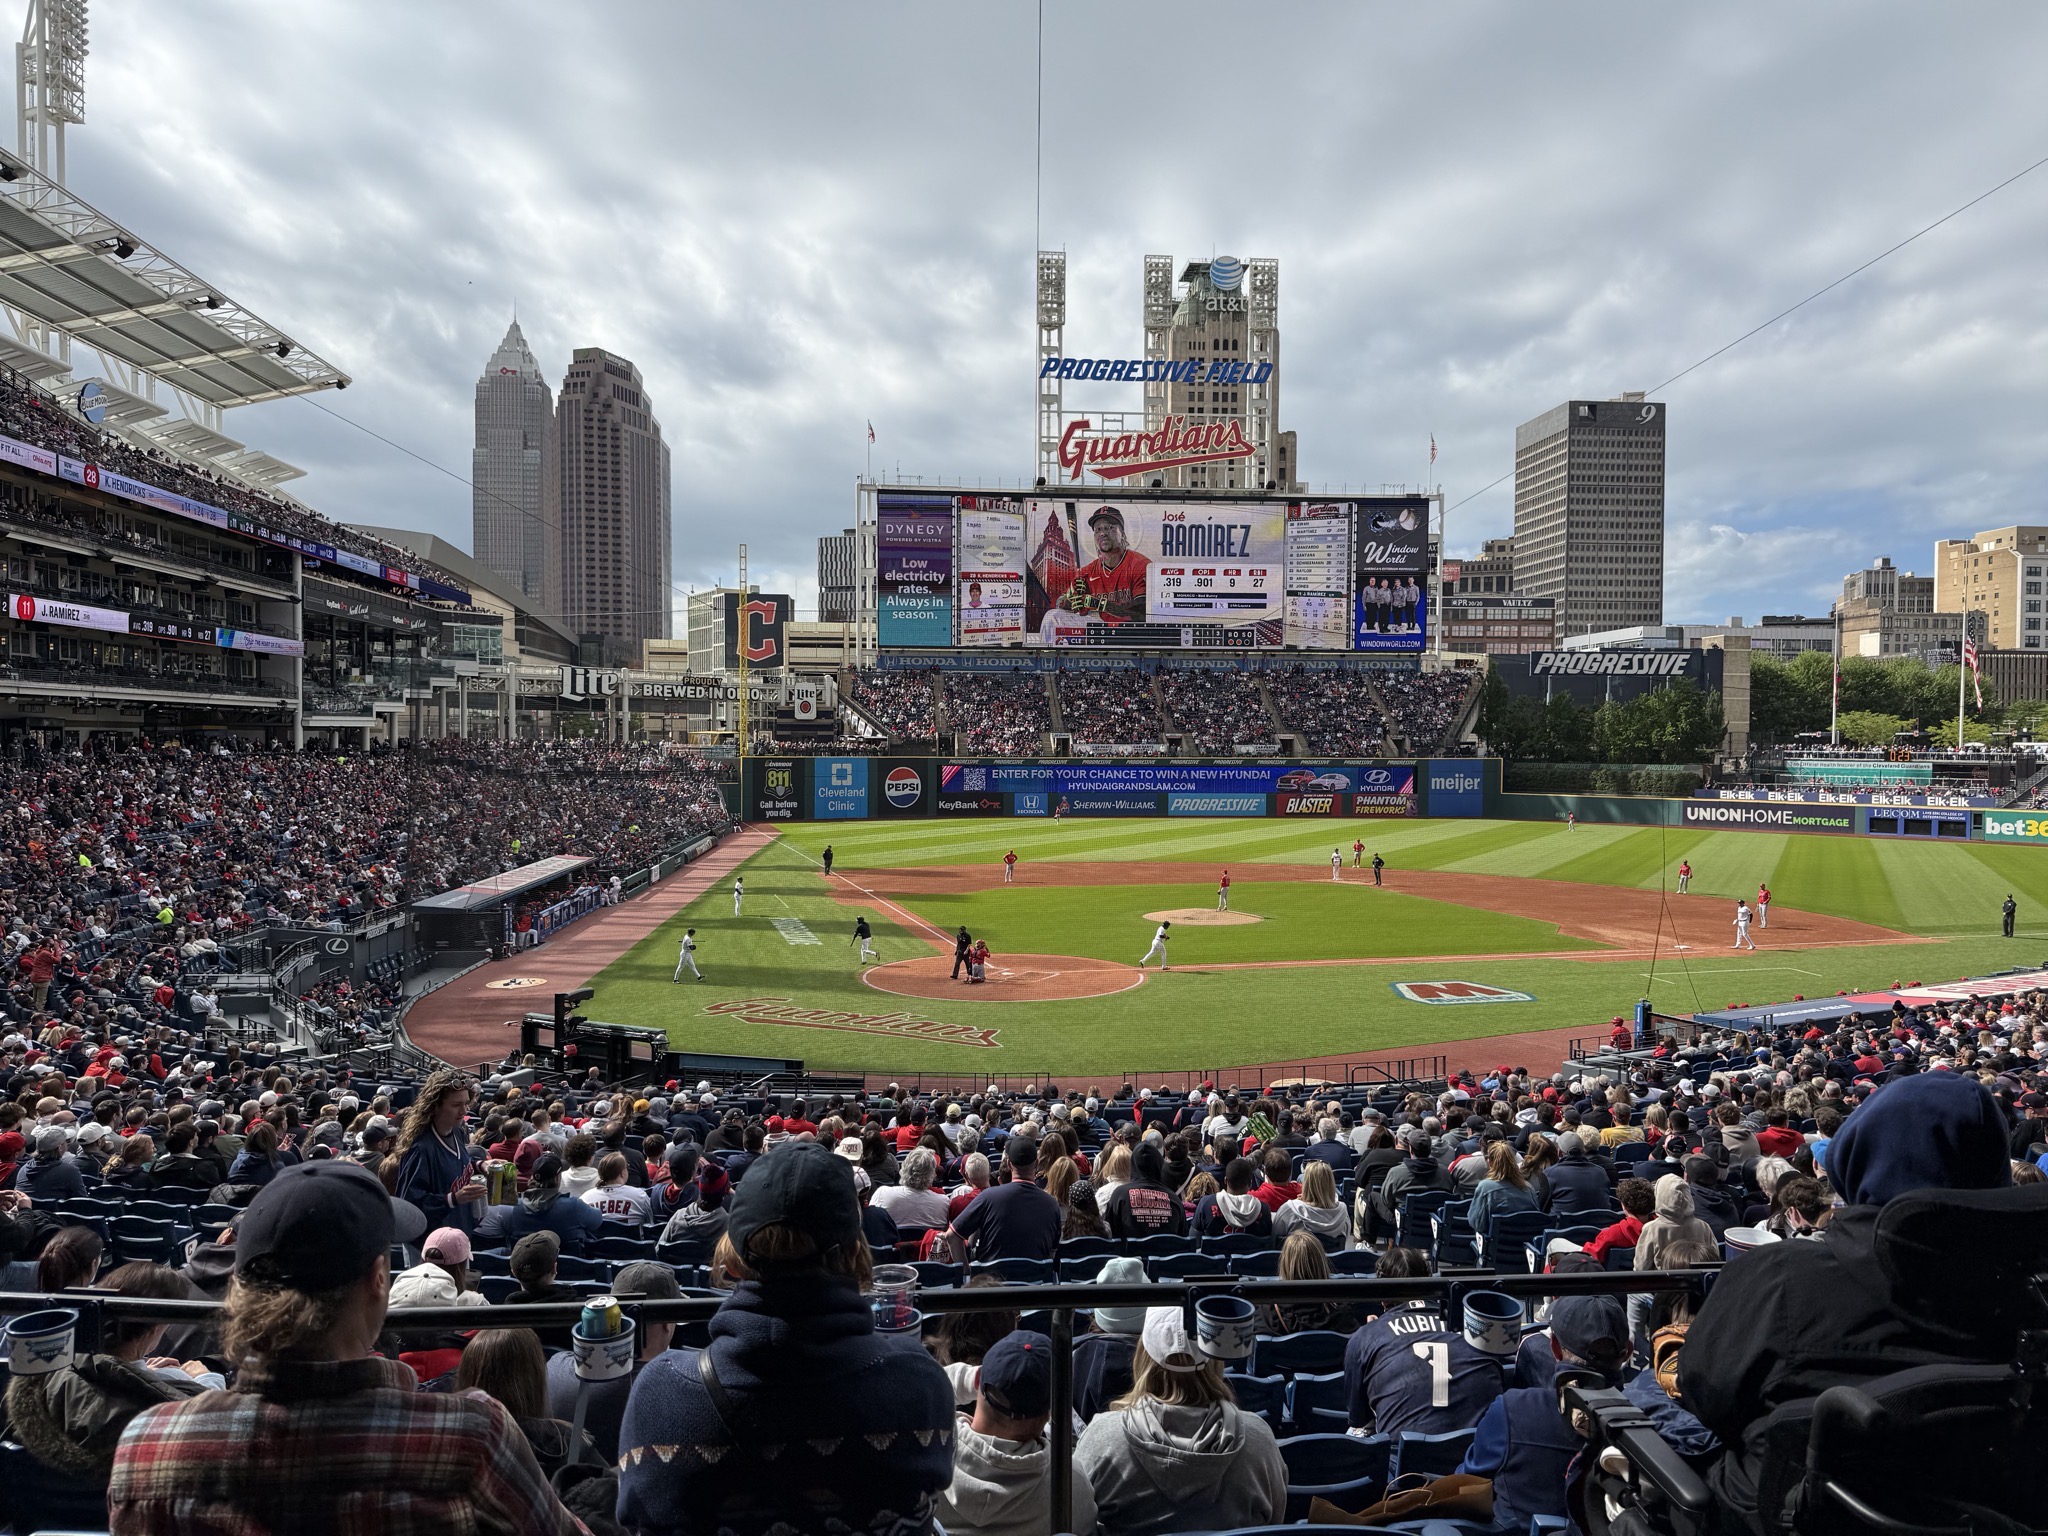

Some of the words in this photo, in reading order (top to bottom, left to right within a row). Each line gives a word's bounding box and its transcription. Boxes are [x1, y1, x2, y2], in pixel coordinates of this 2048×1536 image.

[1205, 295, 1248, 312] at&t
[1039, 357, 1202, 383] PROGRESSIVE
[1204, 361, 1274, 384] FIELD
[1640, 404, 1657, 425] 9
[1057, 415, 1257, 482] Guardians
[32, 454, 53, 469] Ohio.org
[86, 469, 97, 484] 28
[111, 479, 146, 499] HENDRICKS
[980, 499, 1016, 514] ANGELS
[1307, 504, 1340, 518] Guardians
[1162, 510, 1186, 522] José
[885, 524, 945, 536] DYNEGY
[1161, 516, 1252, 558] RAMÍREZ
[901, 557, 928, 569] Low
[884, 570, 945, 585] electricity
[1163, 577, 1182, 587] .319
[1194, 578, 1213, 587] .901
[1229, 578, 1236, 587] 9
[1253, 578, 1264, 588] 27
[898, 584, 932, 594] rates.
[2, 602, 7, 613] 2
[22, 601, 31, 616] 11
[326, 599, 340, 610] KeyBank
[886, 596, 931, 610] Always
[931, 596, 944, 607] in
[41, 604, 48, 617] J.
[49, 604, 80, 621] RAMÍREZ
[892, 610, 938, 620] season.
[141, 621, 154, 633] .319
[166, 625, 178, 636] .901
[204, 630, 211, 640] 27
[737, 600, 777, 663] C
[1360, 640, 1421, 648] WINDOWWORLD.COM
[898, 657, 957, 667] HONDA
[975, 657, 1034, 667] HONDA
[1077, 658, 1136, 668] HONDA
[1181, 659, 1239, 668] HONDA
[1283, 660, 1339, 669] HONDA
[1357, 660, 1414, 669] HONDA
[1533, 653, 1692, 676] PROGRESSIVE
[558, 664, 619, 702] Lite
[683, 677, 723, 686] PROUDLY
[642, 684, 705, 698] BREWED
[709, 685, 724, 699] IN
[796, 688, 815, 700] Lite
[1889, 749, 1910, 762] 0:23
[767, 770, 790, 788] 811
[992, 769, 1029, 779] ENTER
[1031, 769, 1054, 779] FOR
[1055, 769, 1087, 779] YOUR
[1089, 770, 1137, 780] CHANCE
[1138, 770, 1154, 780] TO
[1155, 770, 1179, 780] WIN
[1180, 770, 1188, 780] A
[1189, 770, 1219, 780] NEW
[1220, 770, 1270, 780] HYUNDAI
[887, 782, 919, 792] PEPSI
[1068, 782, 1196, 791] HYUNDAIGRANDSLAM.COM
[1431, 773, 1481, 794] meijer
[818, 787, 865, 798] Cleveland
[759, 800, 774, 809] Call
[775, 800, 798, 809] before
[828, 800, 855, 811] Clinic
[938, 801, 979, 810] KeyBank
[1073, 800, 1156, 810] SHERWIN-WILLIAMS.
[1170, 798, 1262, 811] PROGRESSIVE
[1286, 798, 1333, 814] BLASTER
[1356, 796, 1407, 806] PHANTOM
[766, 810, 779, 819] you
[779, 809, 793, 818] dig.
[1355, 805, 1406, 815] FIREWORKS
[1686, 807, 1793, 825] UNIONHOME
[1792, 816, 1850, 828] MORTGAGE
[694, 996, 1004, 1048] Guardians
[1412, 1341, 1452, 1408] 1
